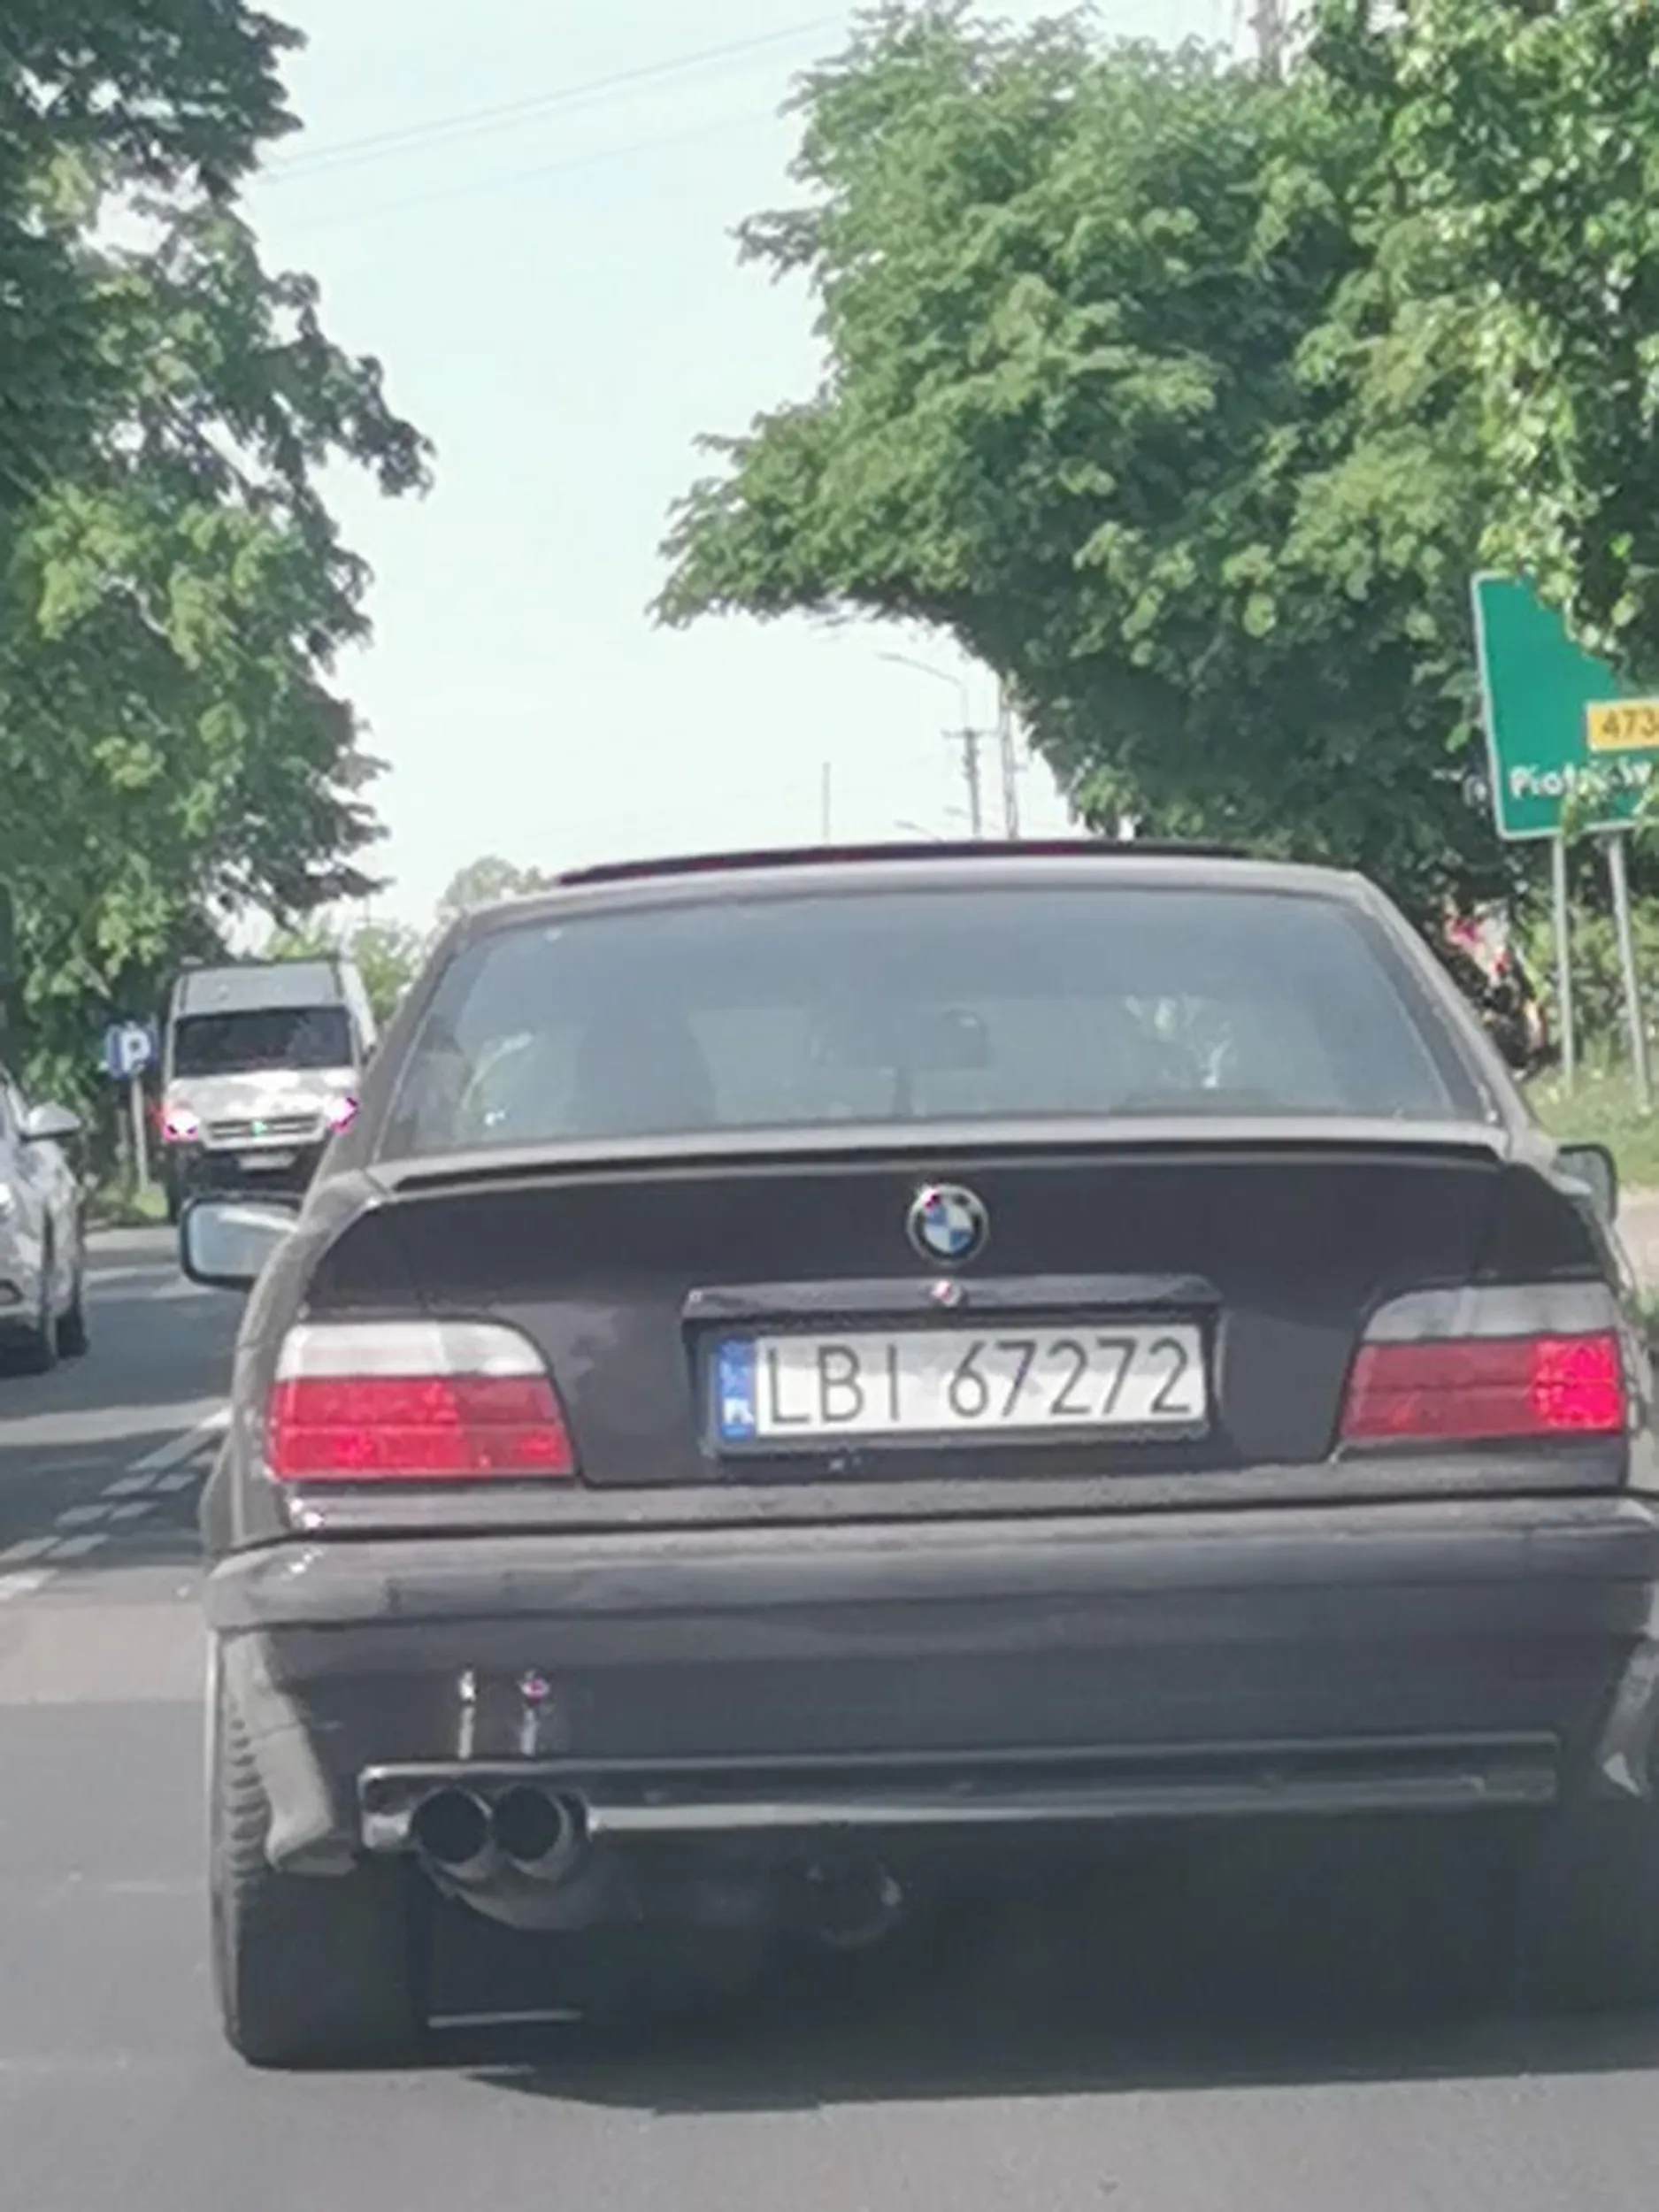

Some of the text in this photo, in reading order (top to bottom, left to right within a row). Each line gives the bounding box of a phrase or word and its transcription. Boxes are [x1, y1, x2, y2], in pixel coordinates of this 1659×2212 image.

[1601, 708, 1659, 739] 473
[120, 1026, 152, 1073] P
[767, 1343, 900, 1425] LBI
[947, 1335, 1192, 1419] 67272
